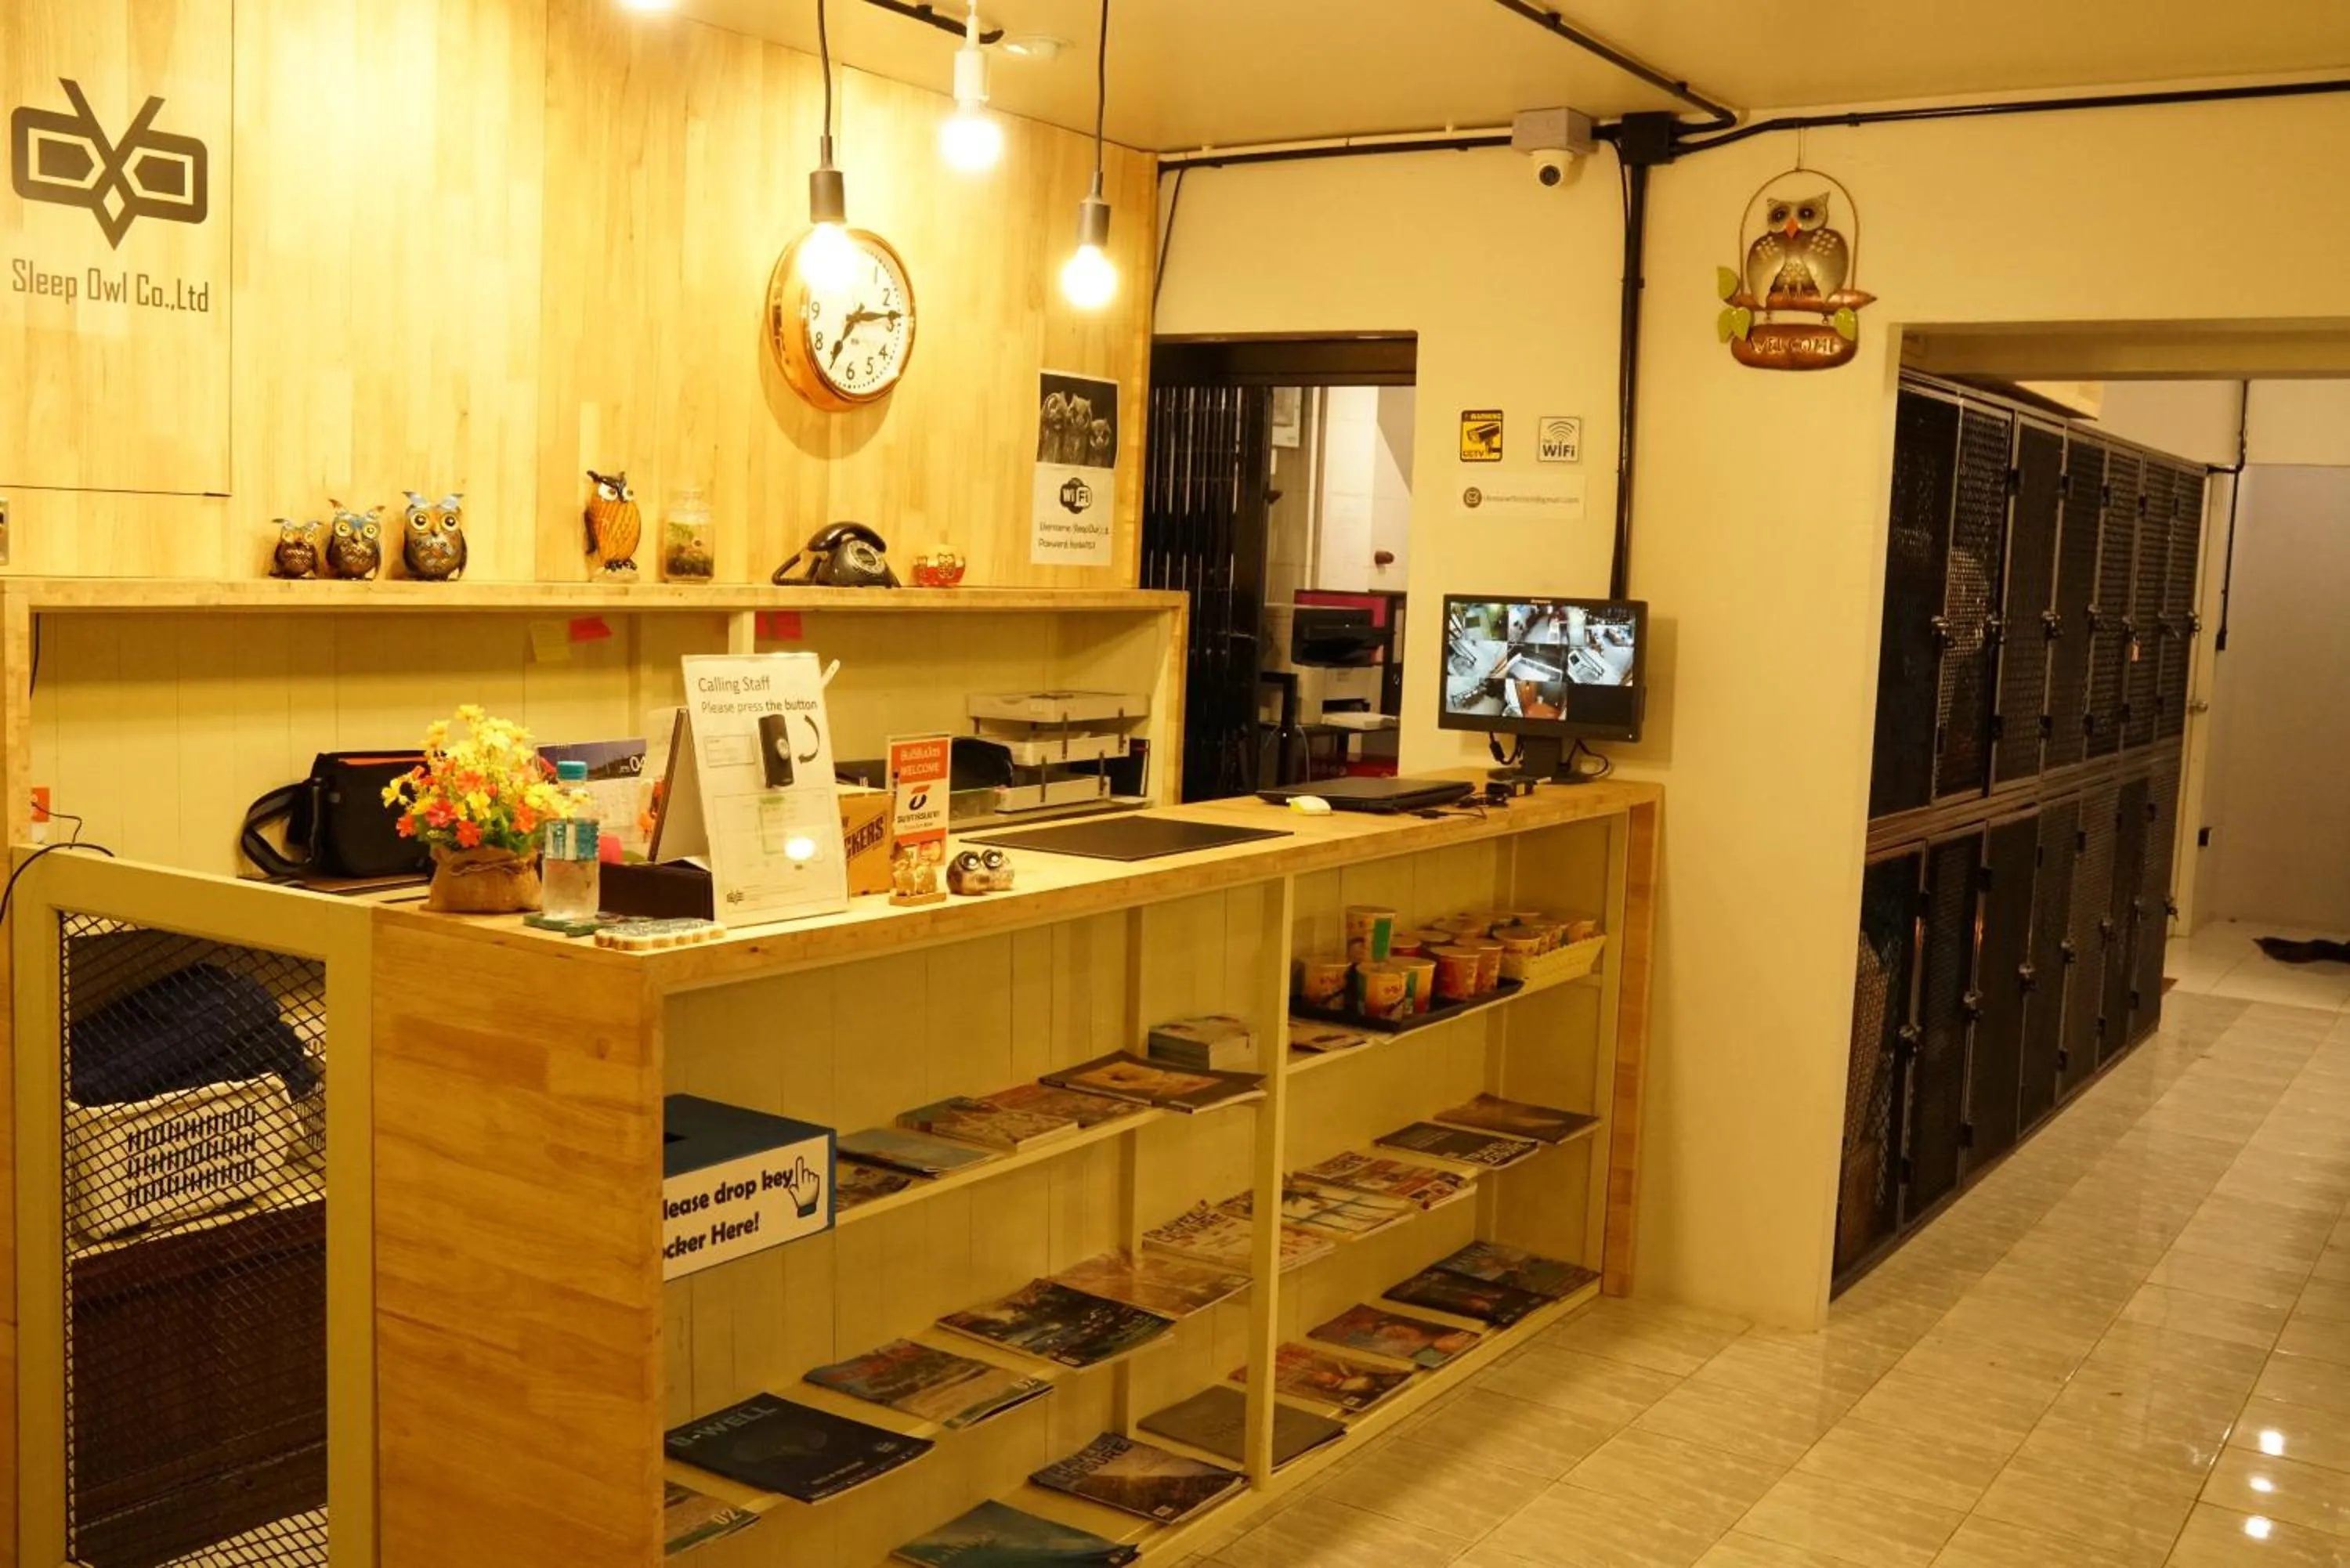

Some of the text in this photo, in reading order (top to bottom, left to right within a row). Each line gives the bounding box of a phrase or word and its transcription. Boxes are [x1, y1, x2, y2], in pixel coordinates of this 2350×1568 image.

[12, 258, 208, 313] Sleep Owl Co.,Ltd
[882, 287, 891, 306] 2
[811, 302, 820, 320] 9
[814, 331, 823, 351] 8
[1750, 336, 1839, 352] WELCOME
[878, 345, 888, 360] 4
[845, 362, 855, 380] 6
[866, 356, 874, 375] 5
[1542, 441, 1575, 457] WiFi
[698, 675, 770, 695] Calling Staff
[701, 699, 818, 714] Please press the button
[663, 1168, 794, 1220] lease drop key
[663, 1211, 760, 1260] cker Here!
